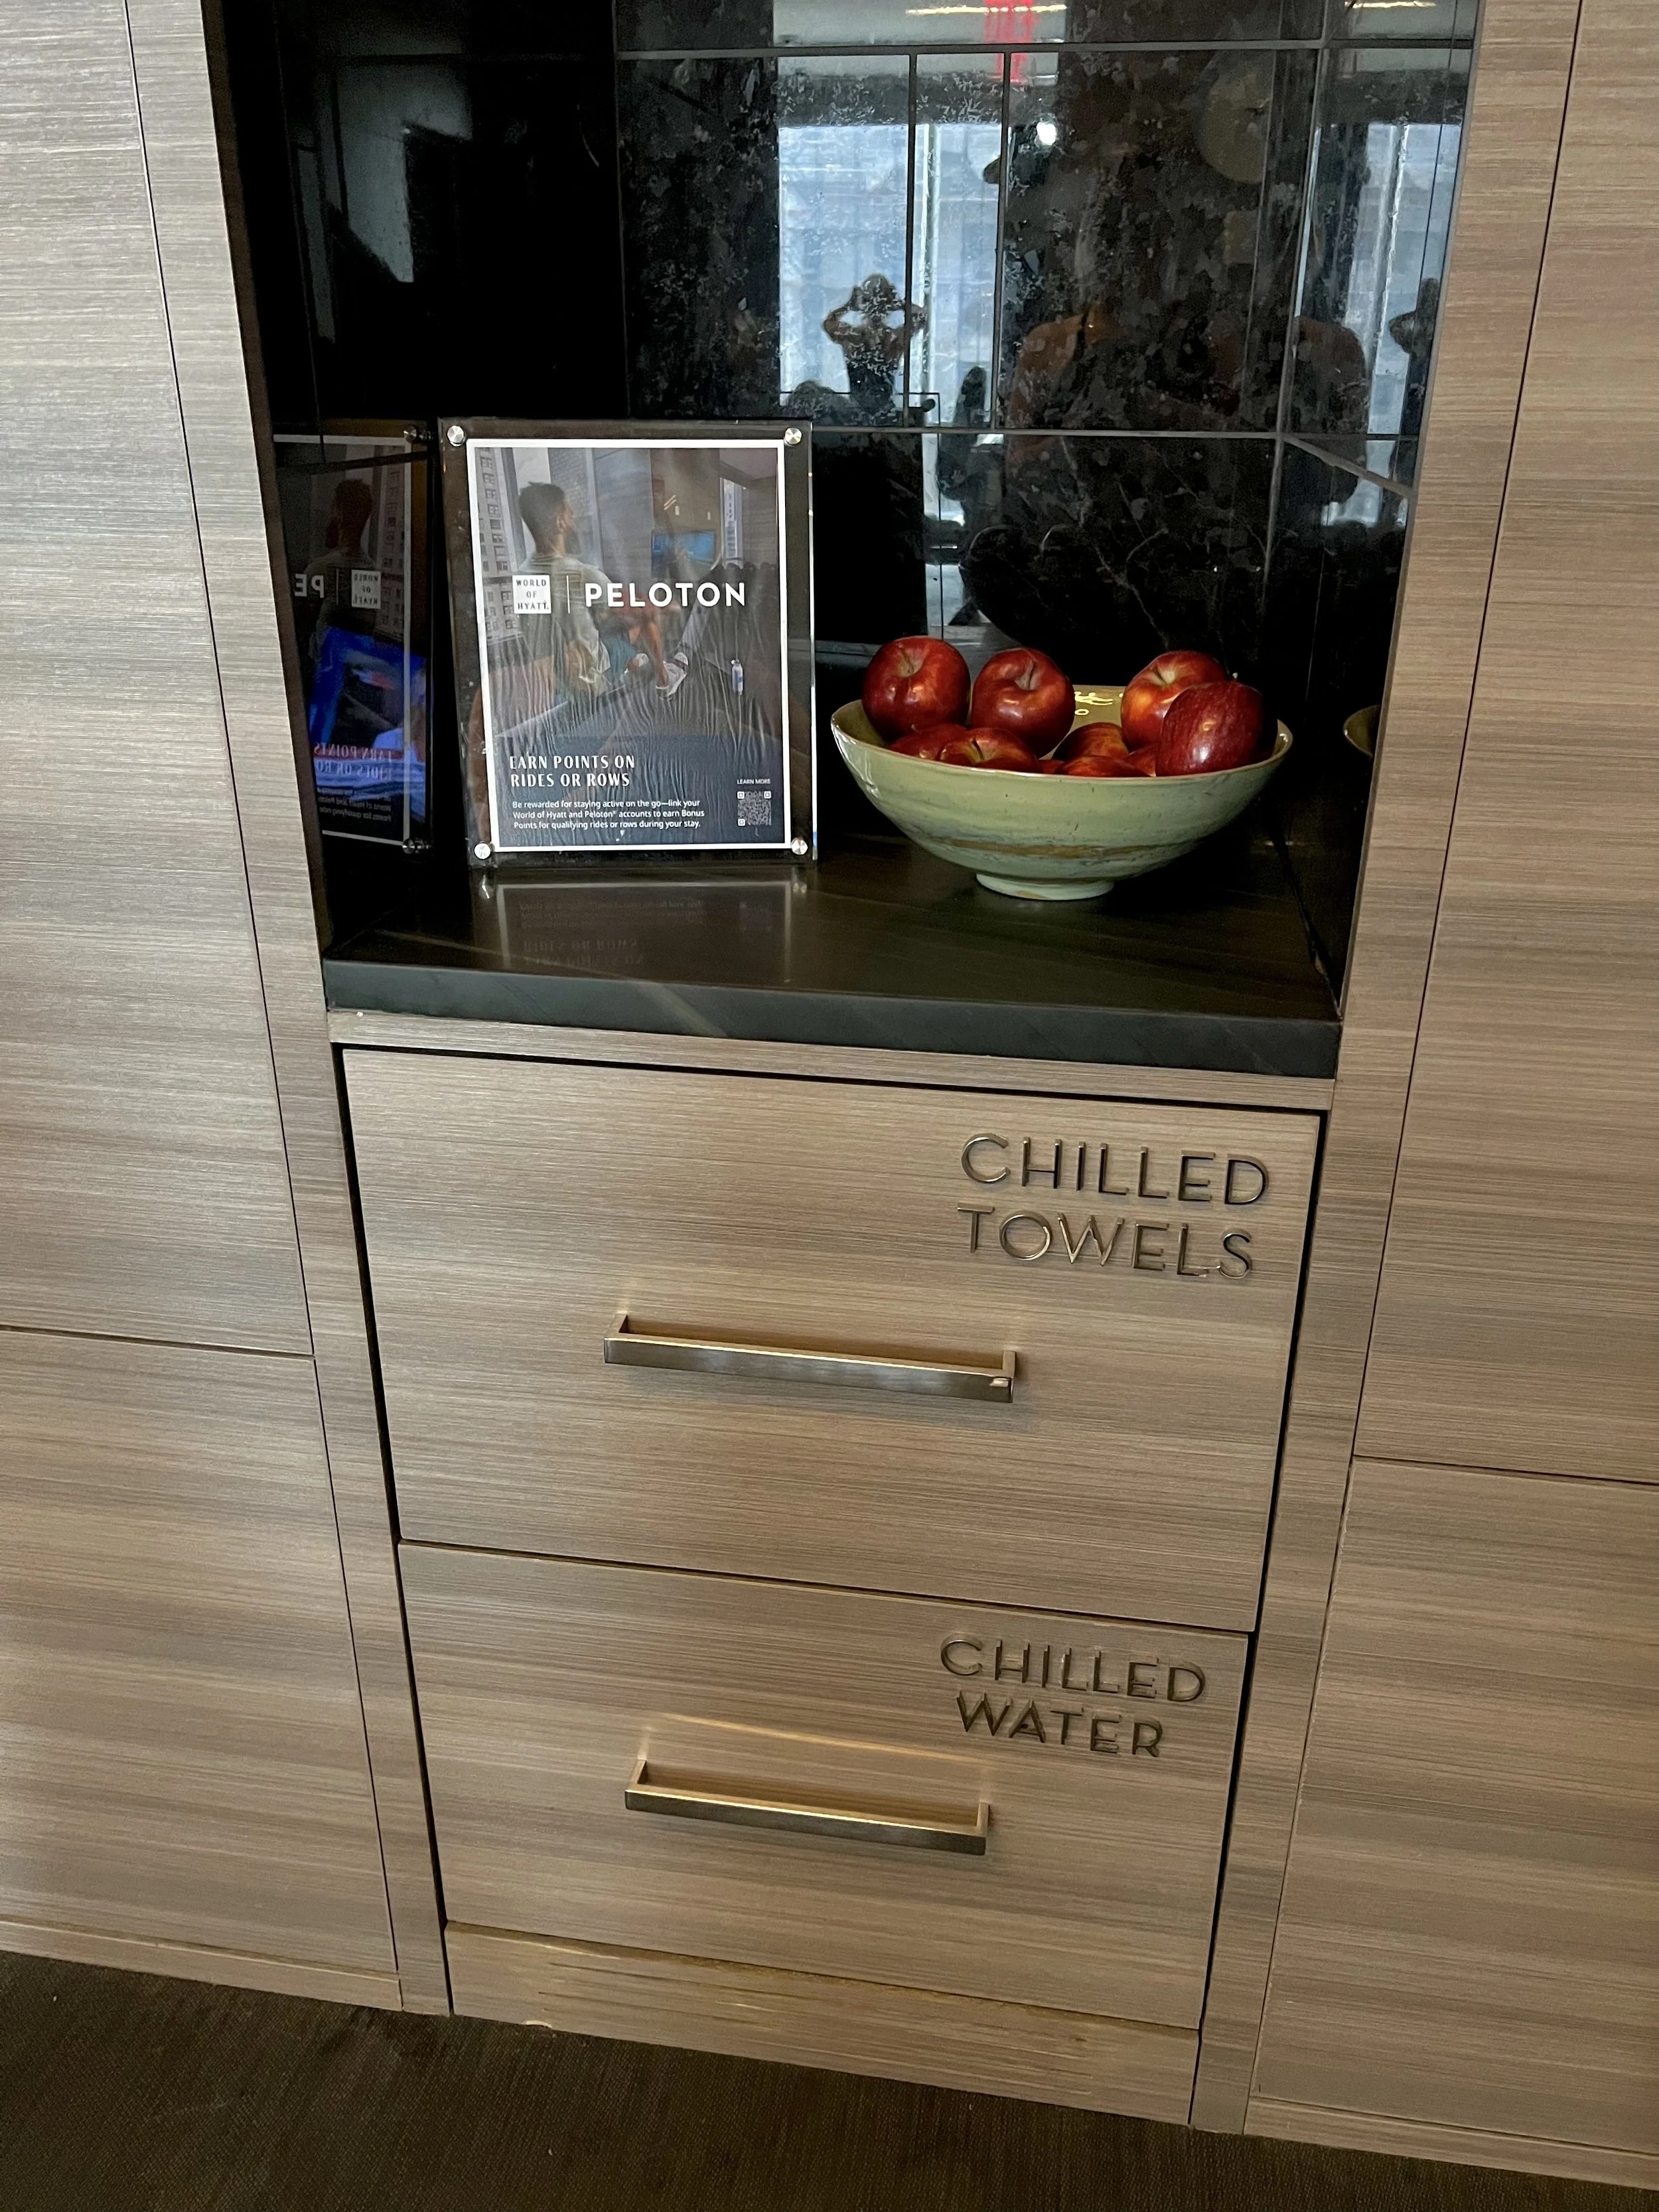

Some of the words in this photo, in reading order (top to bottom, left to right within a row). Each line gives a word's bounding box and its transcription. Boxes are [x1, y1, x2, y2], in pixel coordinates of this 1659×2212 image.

[585, 582, 745, 607] PELOTON
[509, 755, 547, 769] EARN
[553, 755, 609, 769] POINTS
[614, 755, 635, 769] ON
[510, 773, 555, 787] RIDES
[560, 773, 581, 786] OR
[587, 773, 630, 786] ROWS
[573, 800, 601, 810] staying
[683, 800, 701, 808] your
[546, 810, 567, 820] Hyatt
[551, 820, 589, 830] qualifying
[638, 820, 664, 830] during
[962, 1132, 1269, 1205] CHILLED
[957, 1202, 1253, 1280] TOWELS
[940, 1633, 1206, 1702] CHILLED
[956, 1690, 1163, 1758] WATER
